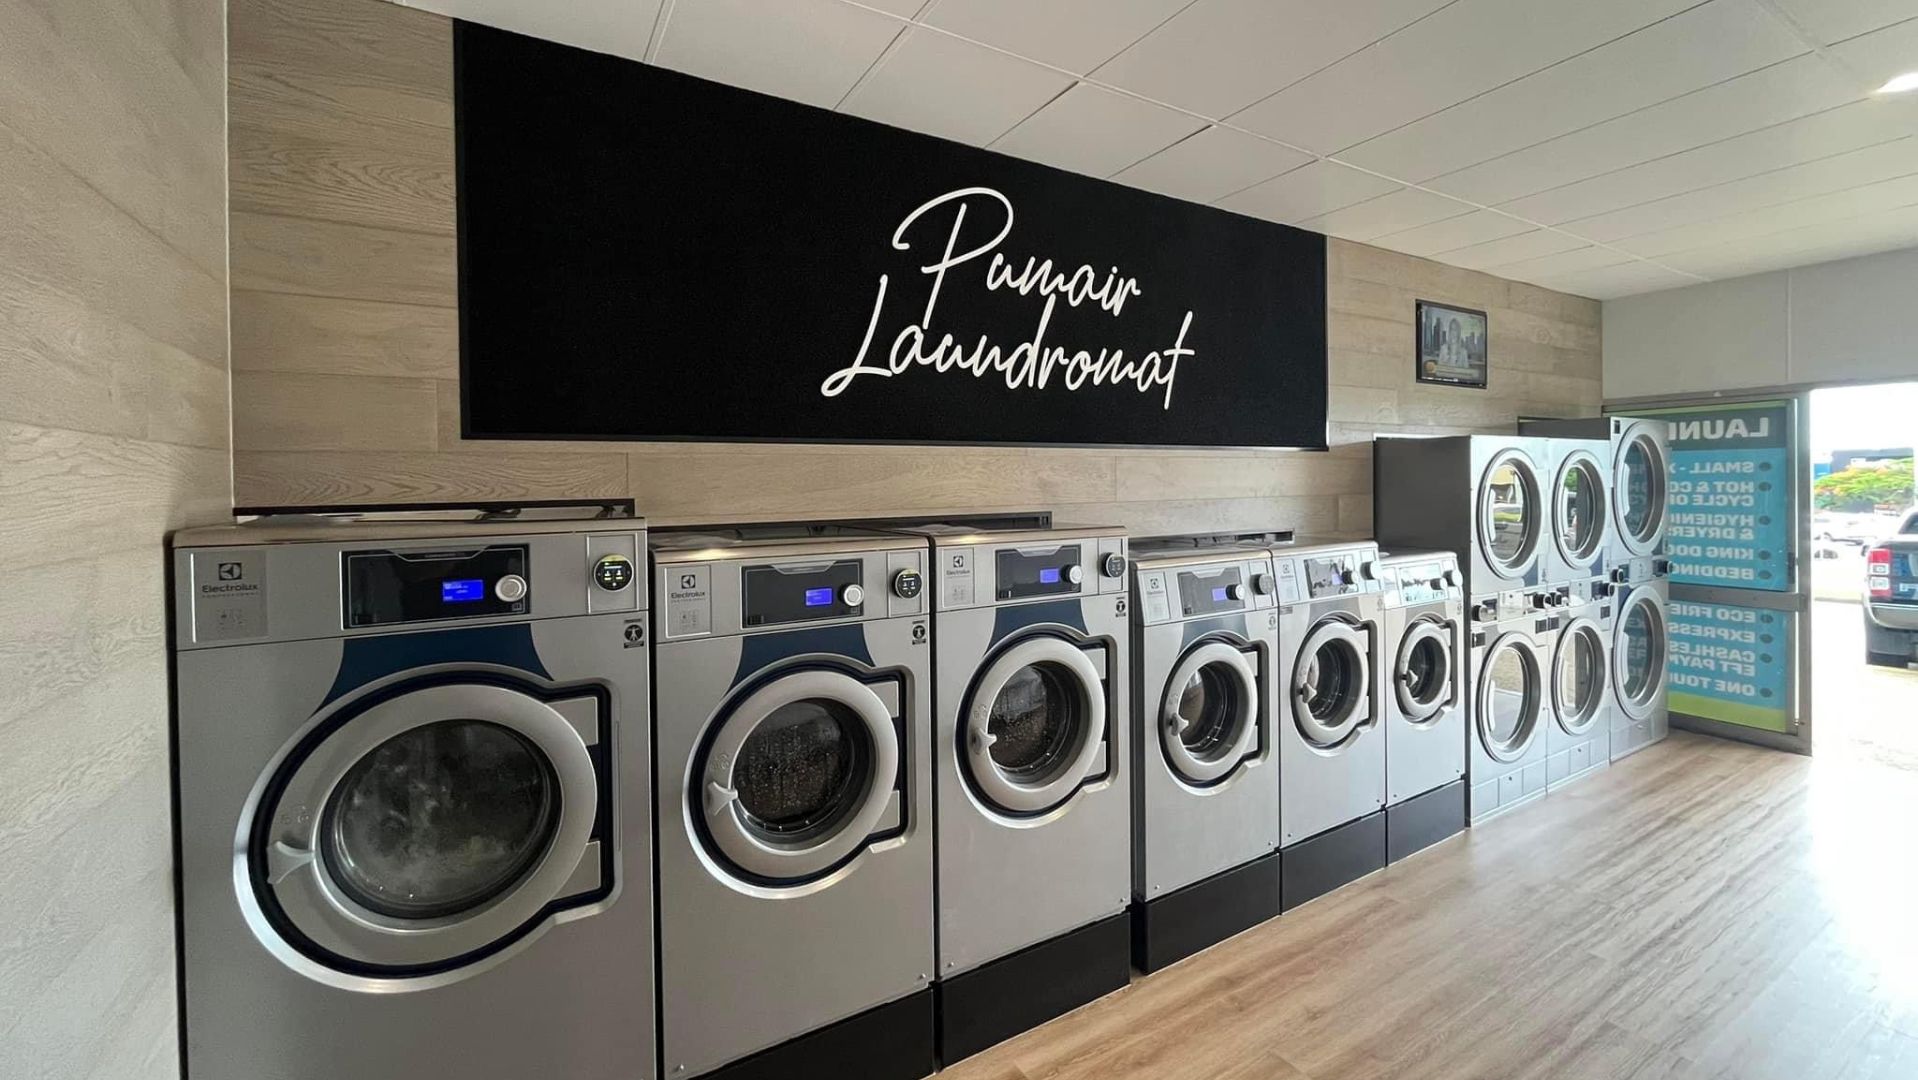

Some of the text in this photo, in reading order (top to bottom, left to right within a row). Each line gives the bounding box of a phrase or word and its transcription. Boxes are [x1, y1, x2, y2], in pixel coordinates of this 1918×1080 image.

[891, 186, 1141, 329] Pumair
[820, 274, 1195, 410] Laundromat
[202, 584, 258, 593] Electrolux
